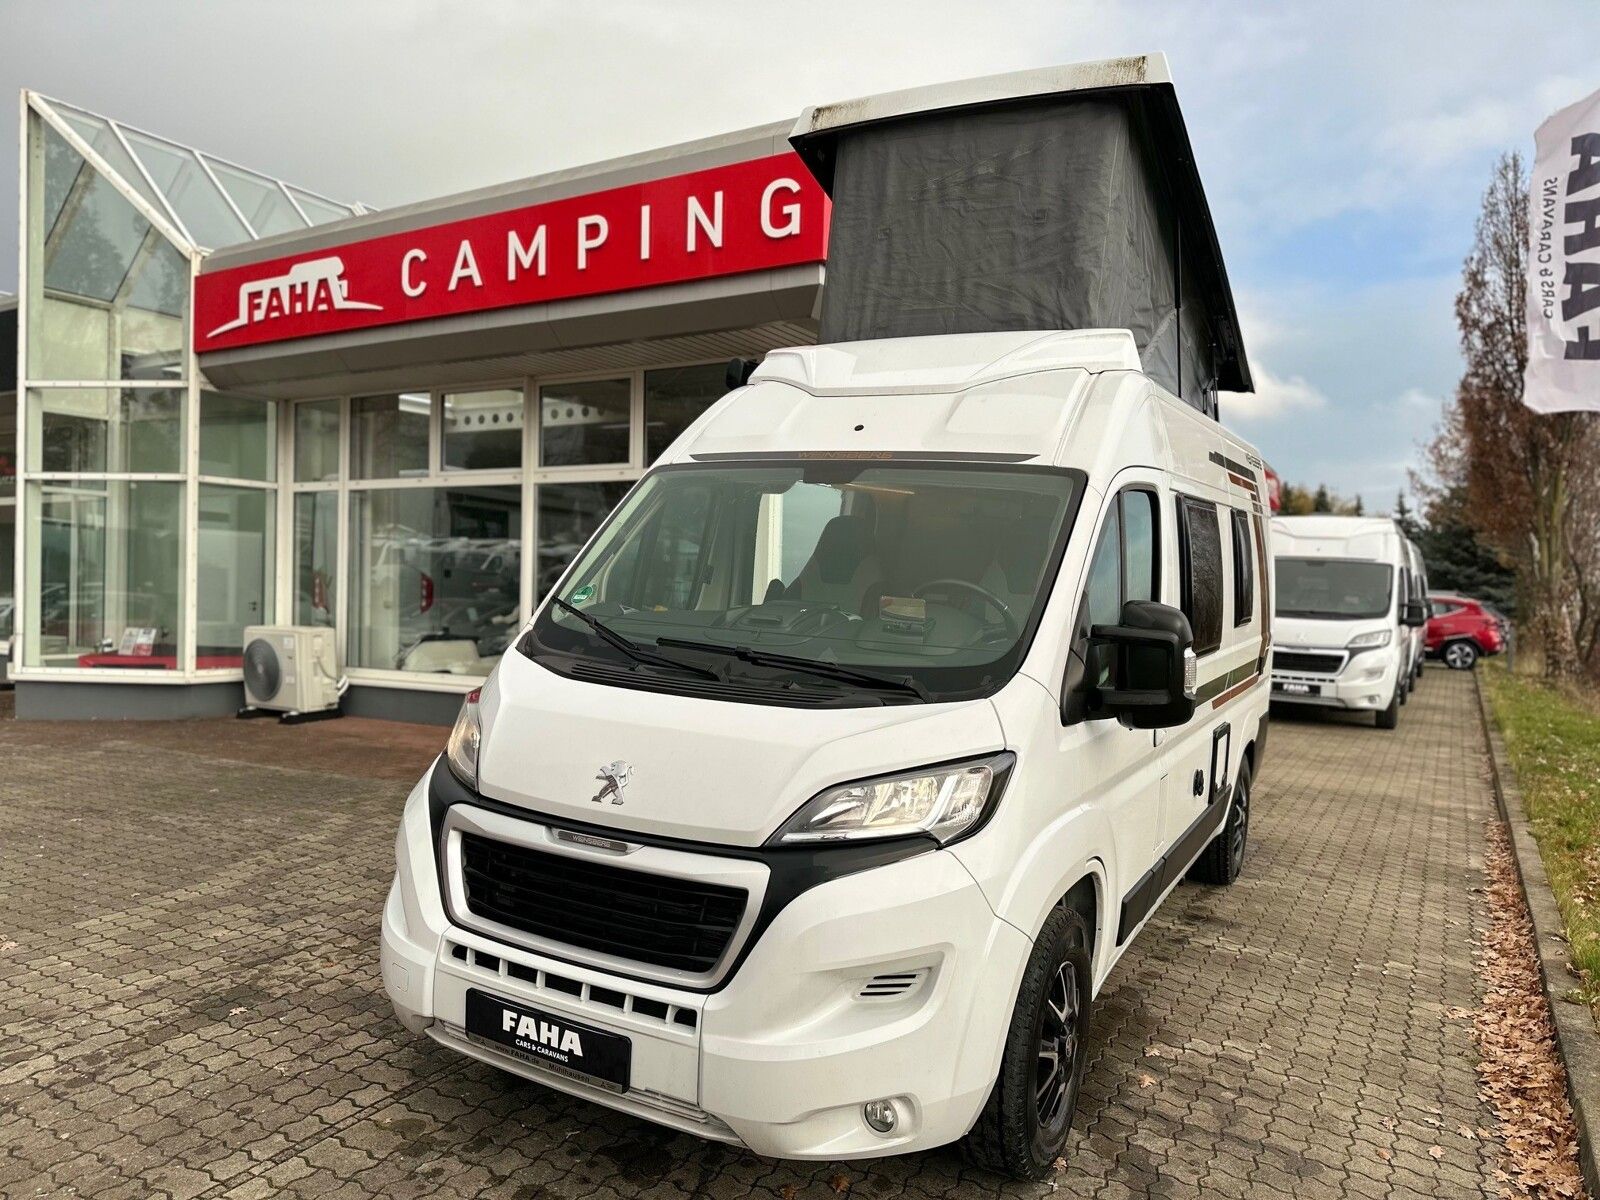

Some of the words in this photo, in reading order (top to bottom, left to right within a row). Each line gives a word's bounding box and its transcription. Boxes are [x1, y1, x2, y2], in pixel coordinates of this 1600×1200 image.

[246, 277, 337, 326] FAHA
[401, 177, 802, 297] CAMPING
[502, 1008, 584, 1058] FAHA
[515, 1038, 531, 1050] CARS
[536, 1047, 569, 1063] CARAVANS
